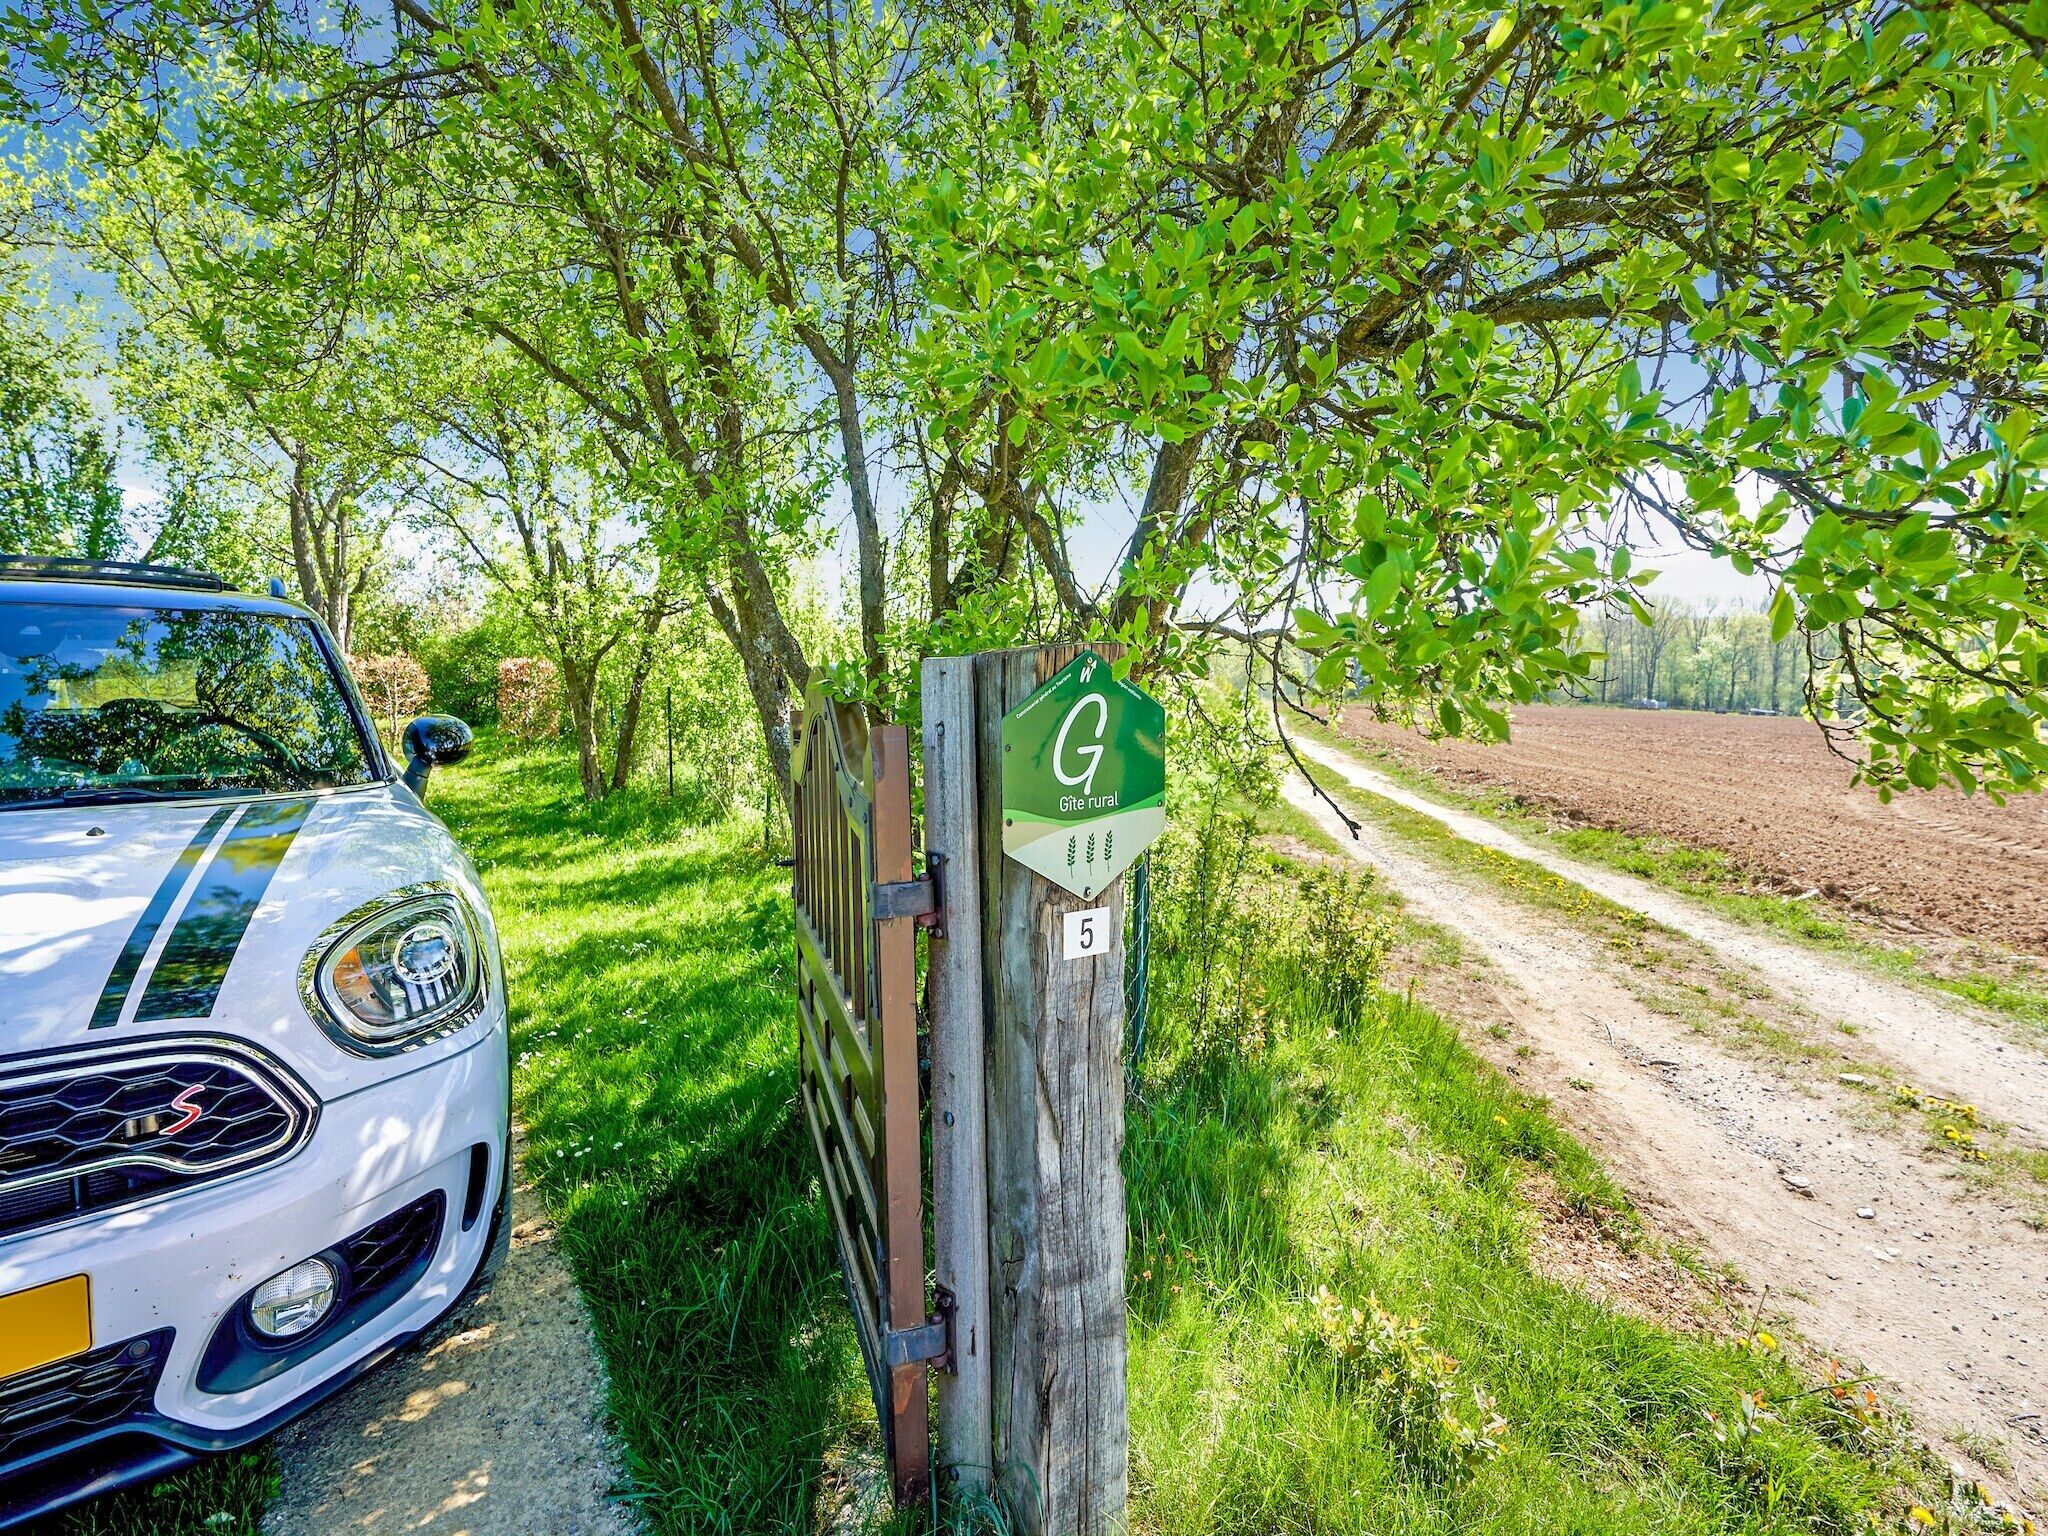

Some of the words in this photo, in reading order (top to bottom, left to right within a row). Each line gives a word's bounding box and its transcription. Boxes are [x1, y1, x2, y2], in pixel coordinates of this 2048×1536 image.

[1053, 692, 1108, 796] G
[1059, 795, 1085, 812] Gîte
[1088, 790, 1119, 809] rural
[1080, 917, 1094, 950] 5
[159, 1083, 206, 1136] S
